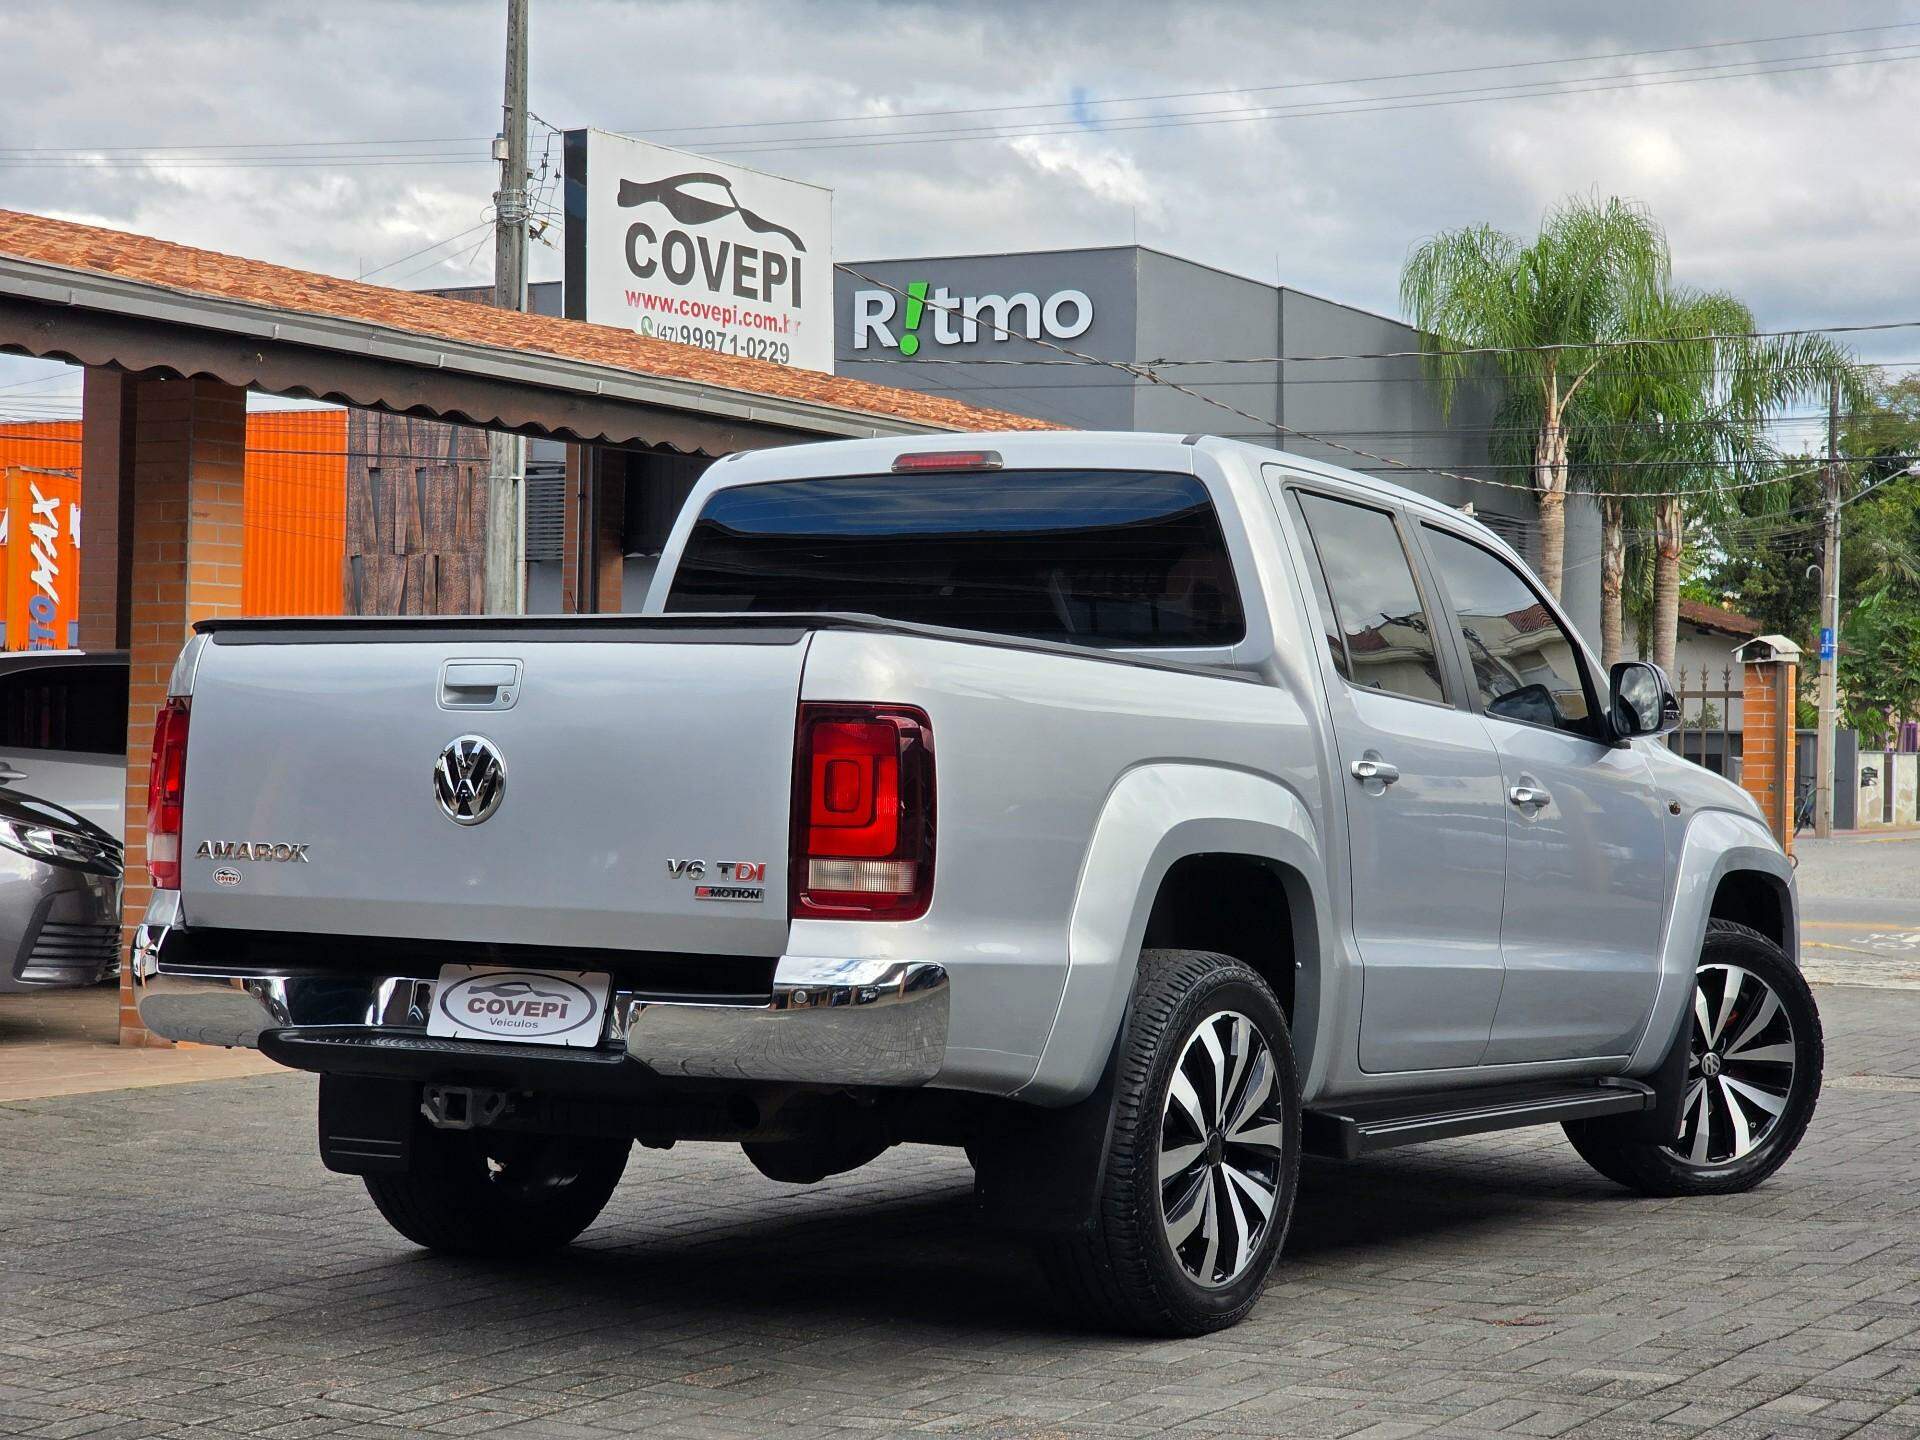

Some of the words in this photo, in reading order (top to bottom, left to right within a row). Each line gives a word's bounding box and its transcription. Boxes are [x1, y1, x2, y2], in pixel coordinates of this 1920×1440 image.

[624, 221, 802, 309] COVEPI
[194, 840, 310, 863] AMAROK
[666, 858, 706, 881] V6
[716, 860, 767, 882] TDI
[467, 998, 569, 1020] COVEPI
